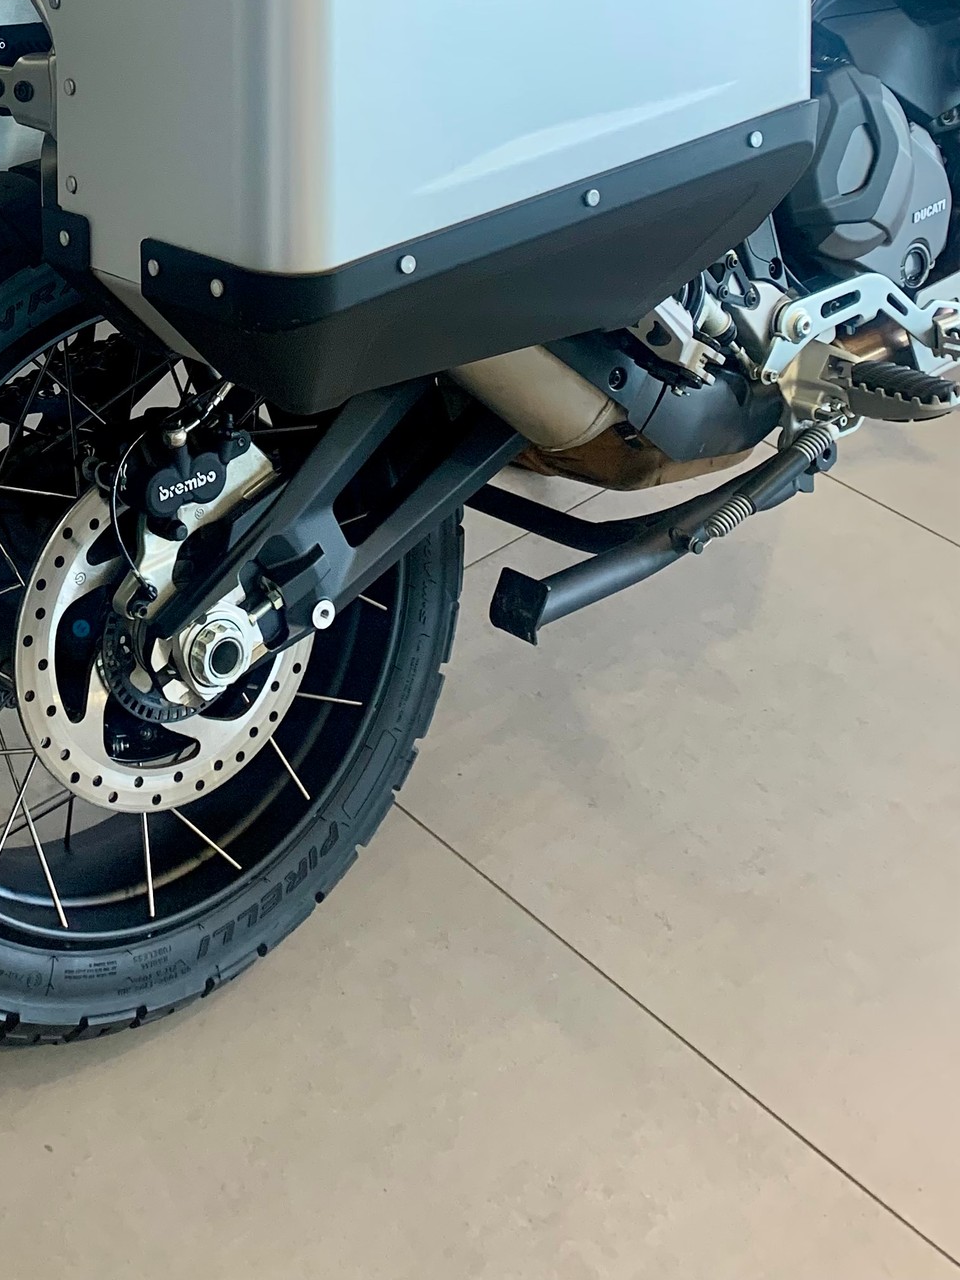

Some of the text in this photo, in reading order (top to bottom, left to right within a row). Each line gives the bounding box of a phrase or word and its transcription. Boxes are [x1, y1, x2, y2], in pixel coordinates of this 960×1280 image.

[914, 198, 946, 223] DUCATI
[158, 470, 217, 502] brembo
[196, 819, 340, 960] PIRELLI
